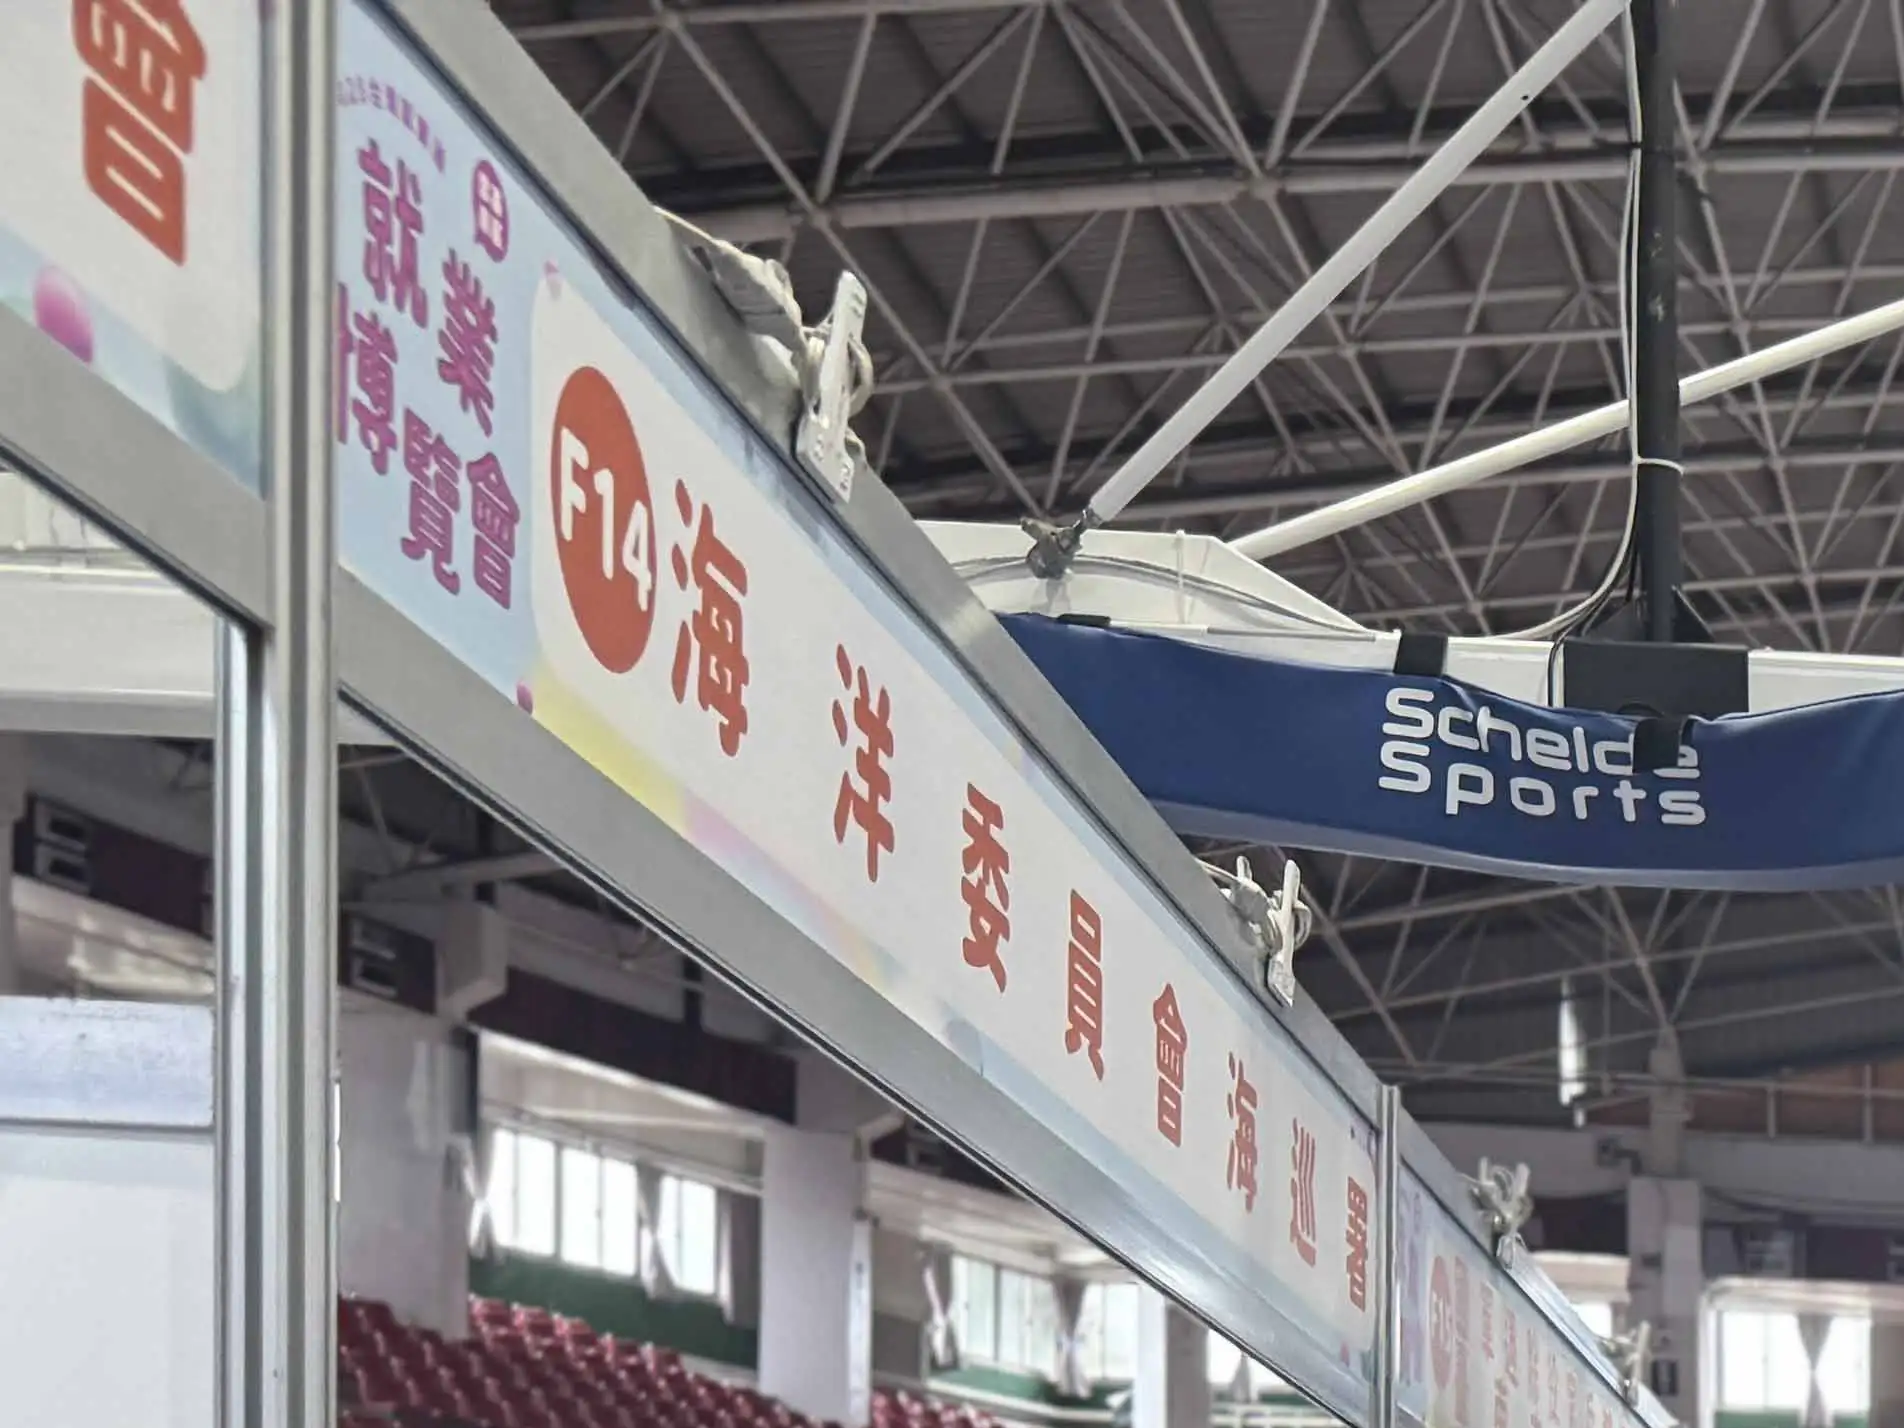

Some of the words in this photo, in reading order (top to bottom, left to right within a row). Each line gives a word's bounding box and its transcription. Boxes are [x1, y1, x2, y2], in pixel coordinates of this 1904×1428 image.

[559, 433, 652, 612] F14
[1378, 740, 1706, 825] Sports
[670, 477, 1368, 1312] 海洋委員會海巡署
